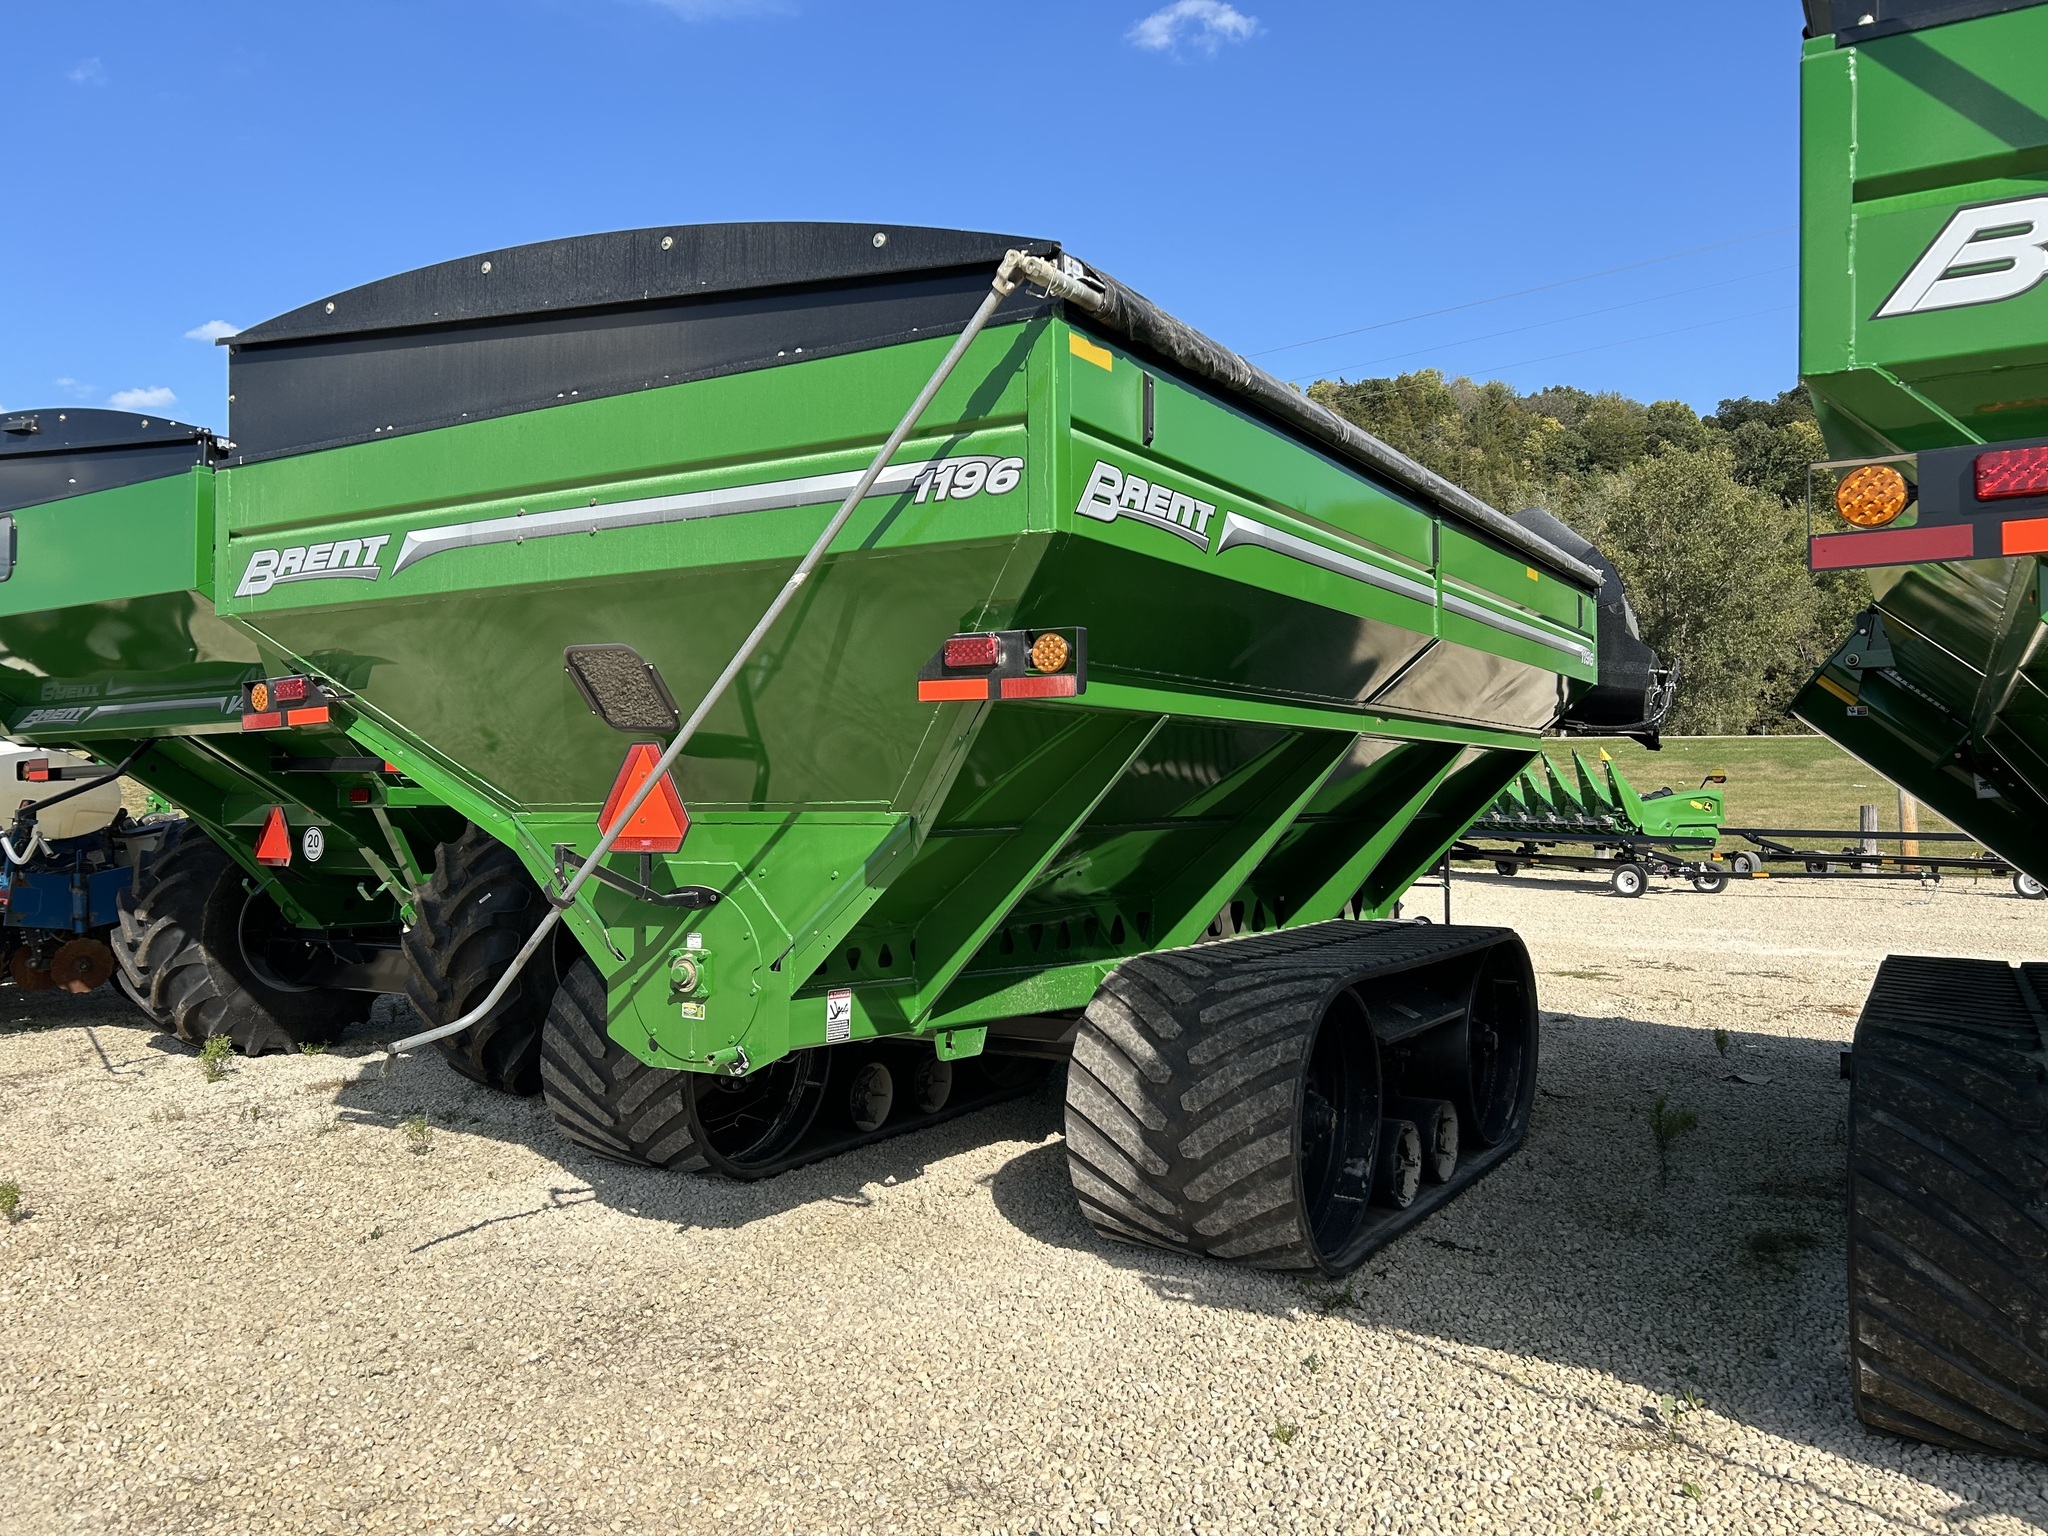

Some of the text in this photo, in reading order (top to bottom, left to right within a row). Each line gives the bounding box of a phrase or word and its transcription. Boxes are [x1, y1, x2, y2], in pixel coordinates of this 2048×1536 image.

[1872, 195, 2048, 319] B
[913, 457, 1024, 504] 1196
[1075, 460, 1217, 536] BRENT
[234, 534, 391, 597] BRENT
[14, 706, 91, 729] BRENT
[307, 834, 320, 848] 20
